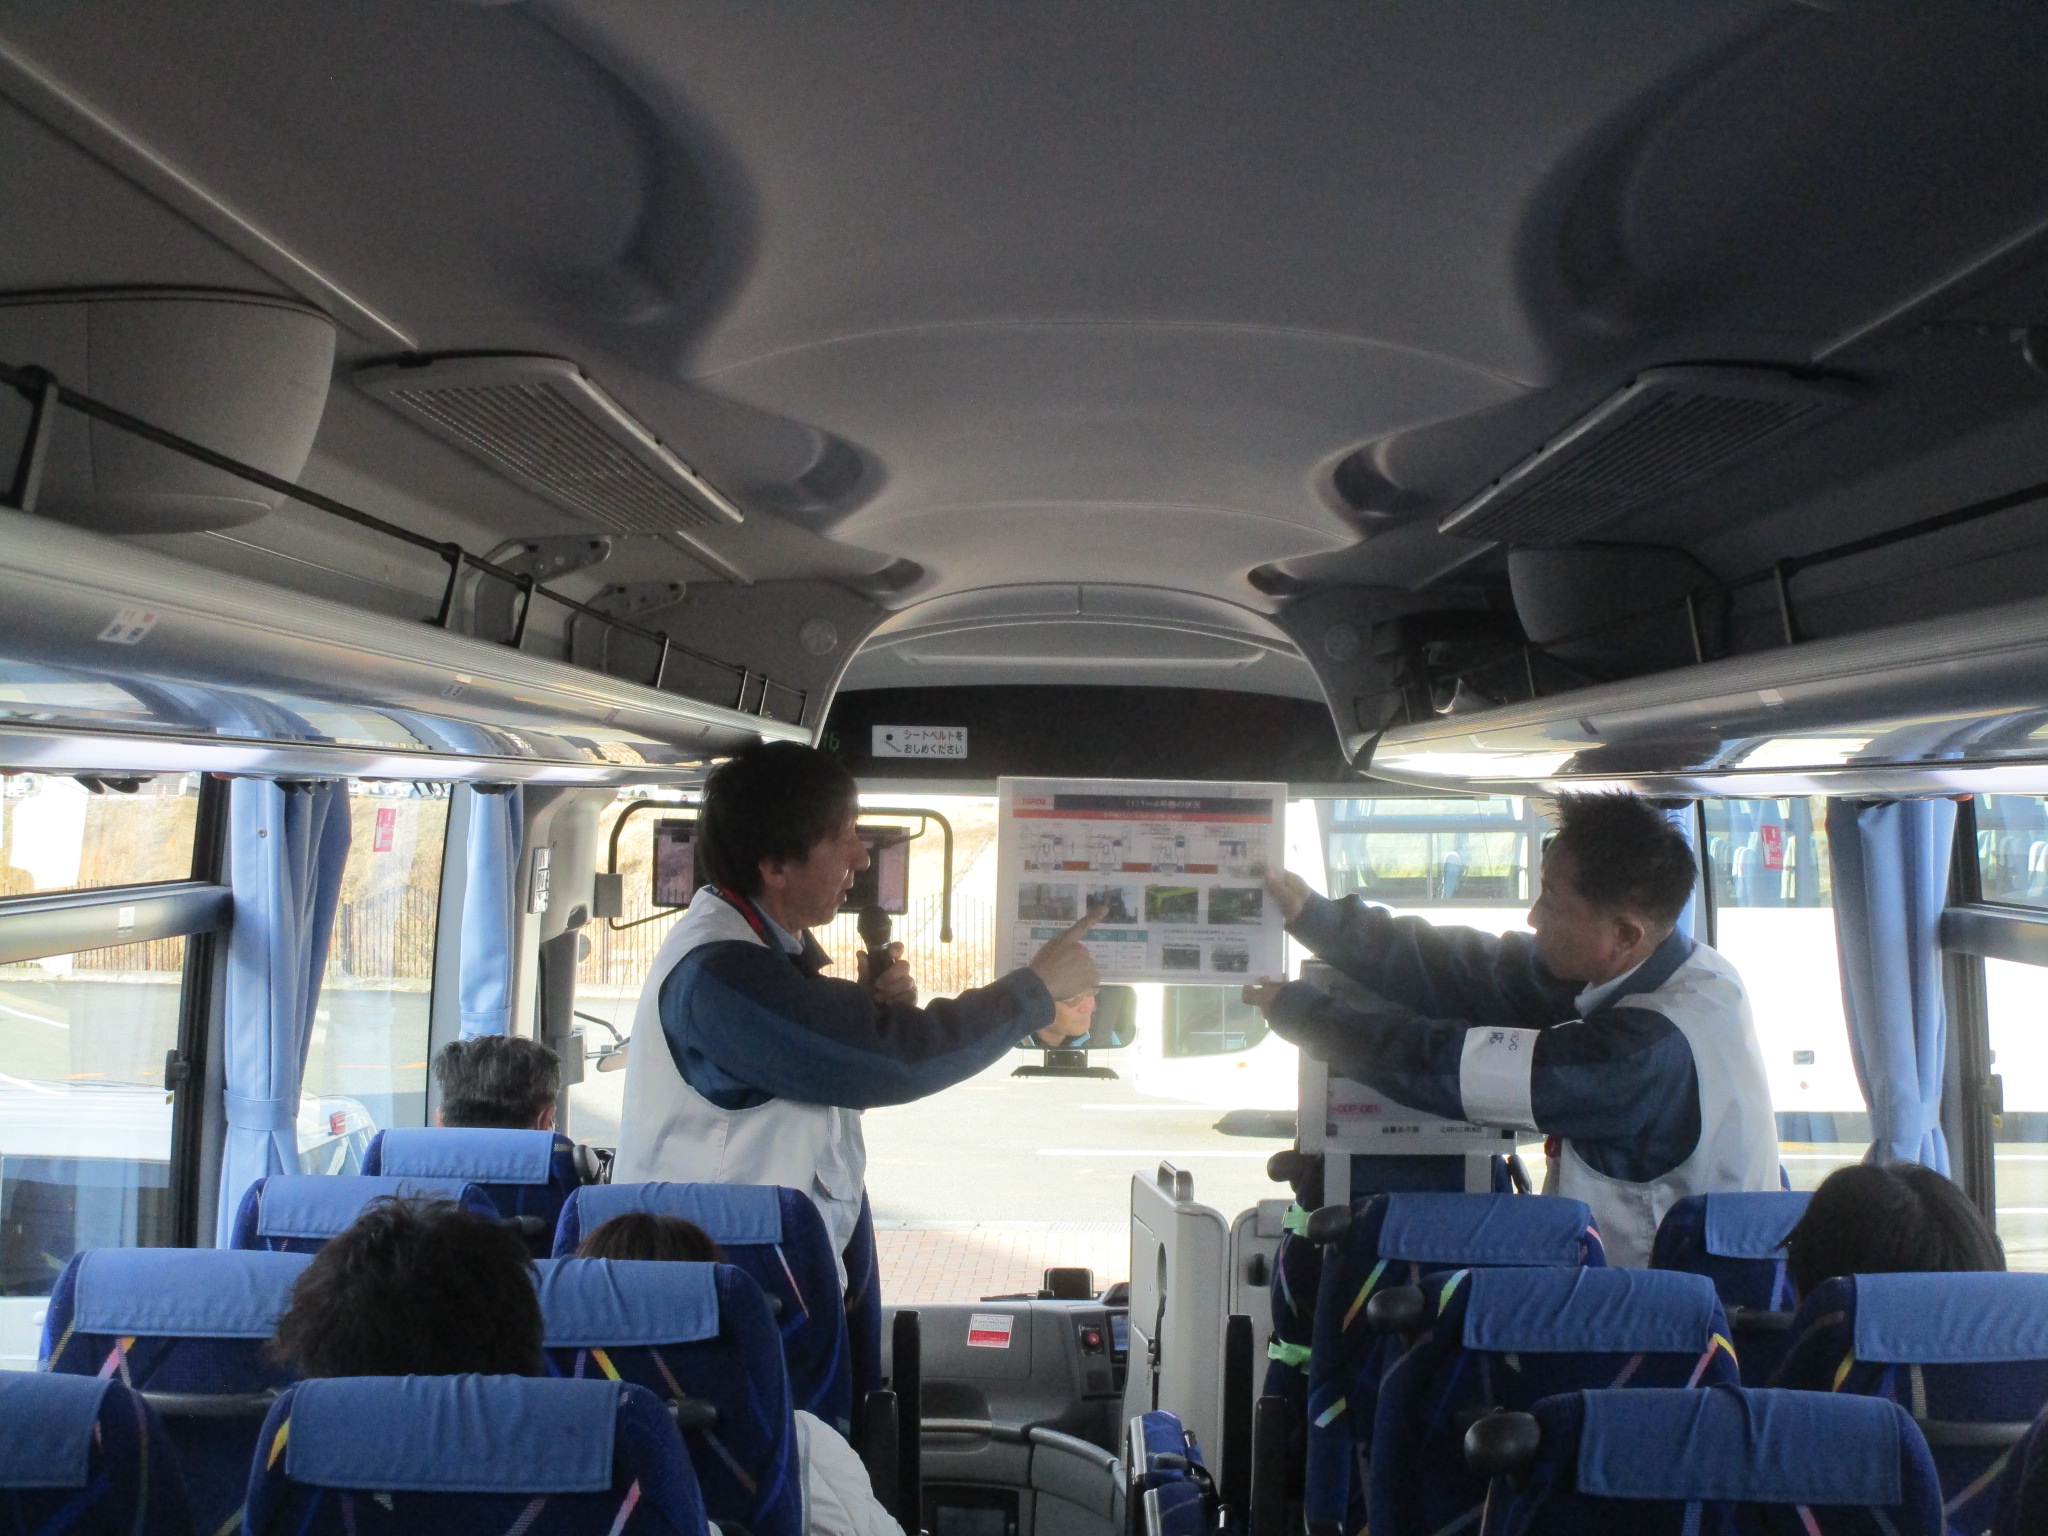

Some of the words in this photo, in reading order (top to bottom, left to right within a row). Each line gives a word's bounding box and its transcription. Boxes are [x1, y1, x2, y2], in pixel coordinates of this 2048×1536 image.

[904, 730, 964, 741] シートベルトを
[904, 744, 964, 754] おしめください
